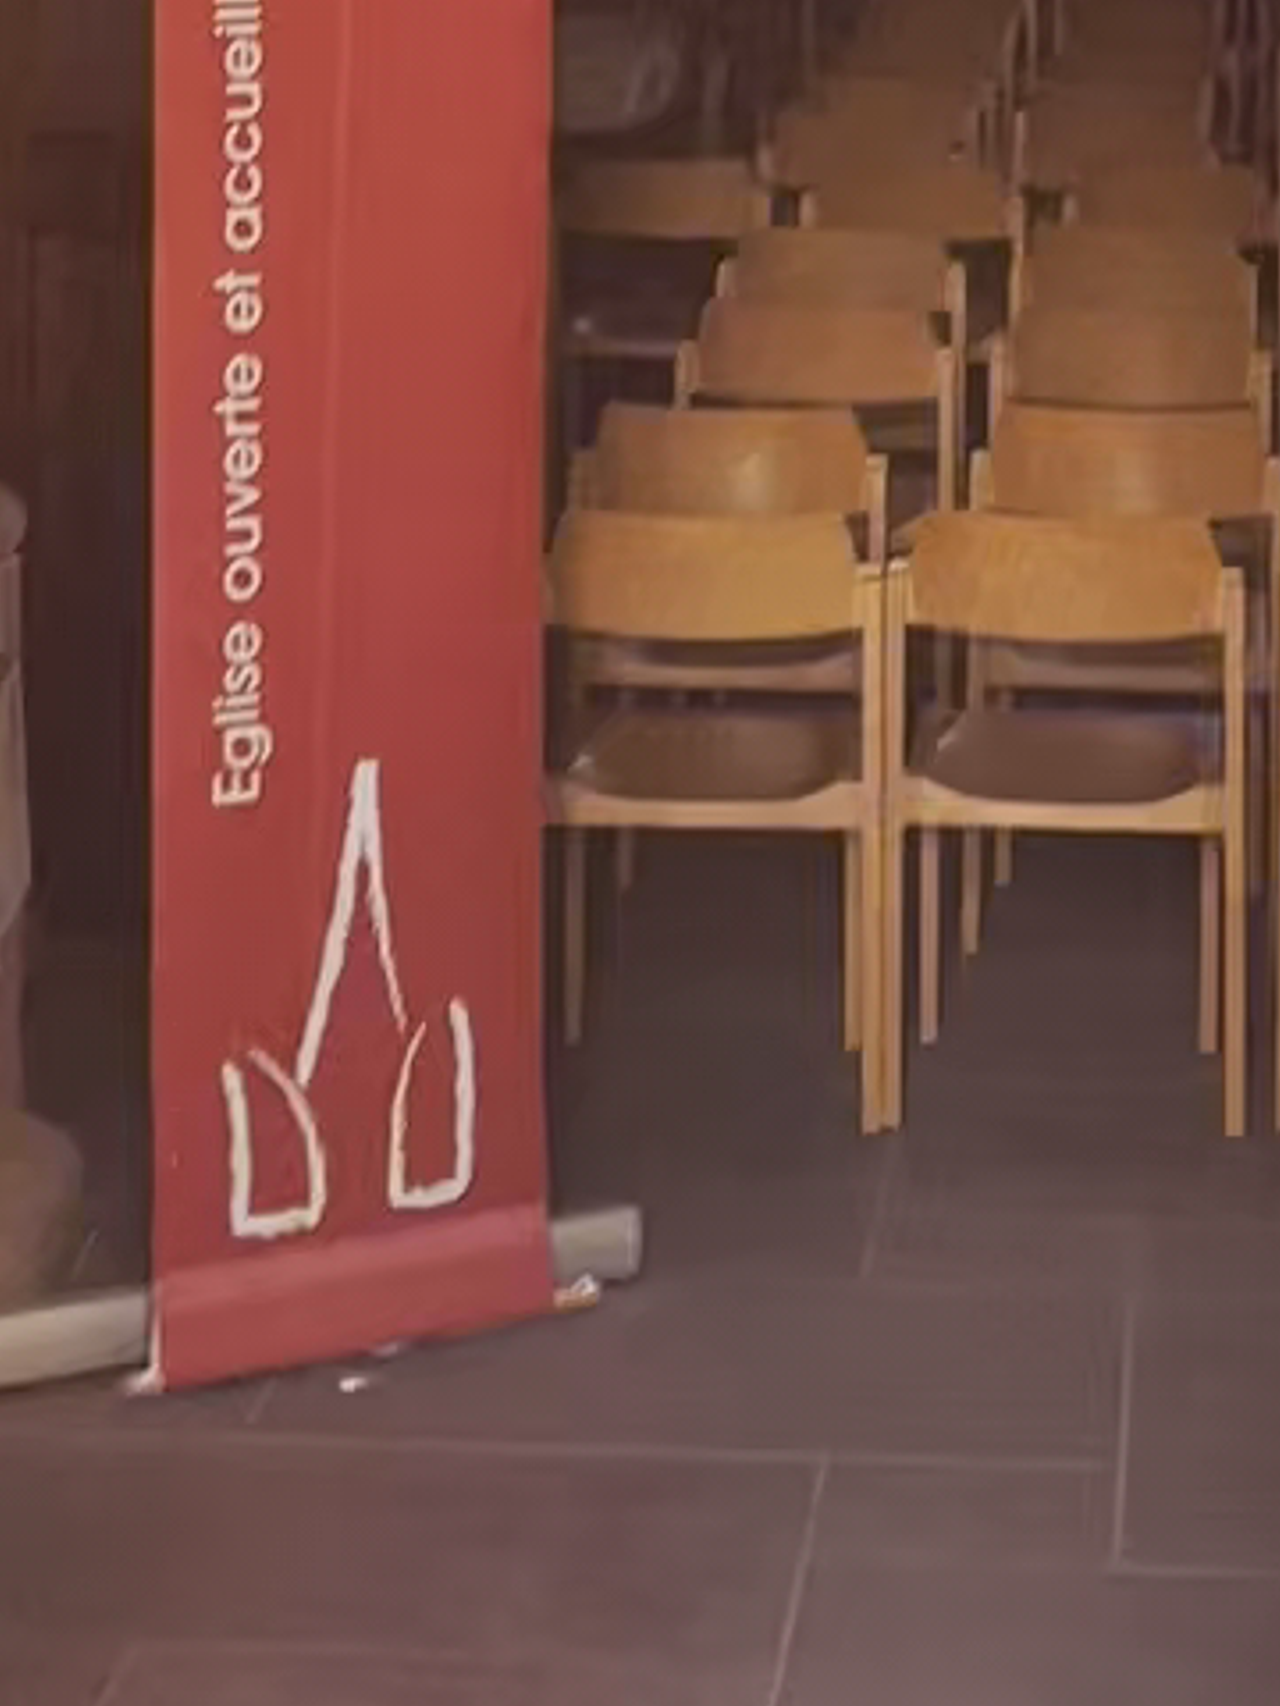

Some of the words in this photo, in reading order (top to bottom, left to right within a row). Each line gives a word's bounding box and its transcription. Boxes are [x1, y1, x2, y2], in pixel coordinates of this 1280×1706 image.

[214, 268, 263, 334] et
[214, 352, 263, 603] ouverte
[211, 620, 273, 807] Eglise
